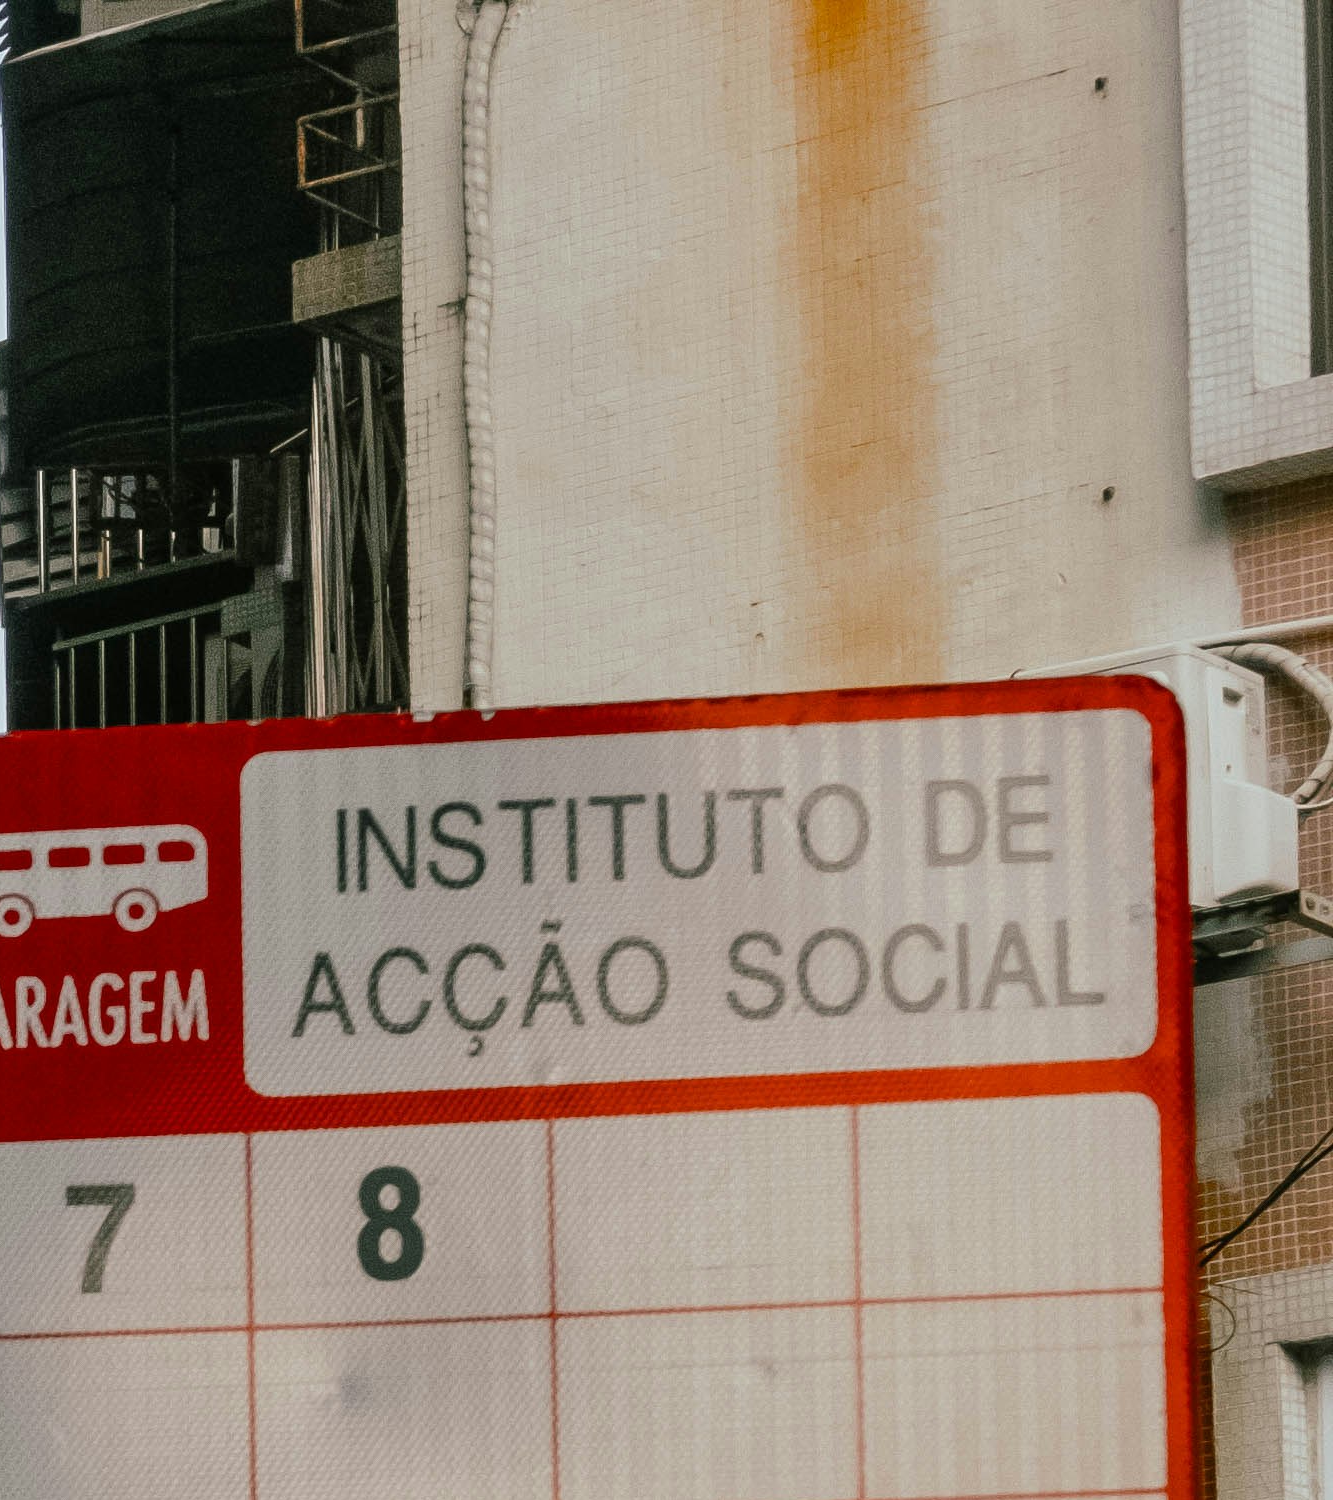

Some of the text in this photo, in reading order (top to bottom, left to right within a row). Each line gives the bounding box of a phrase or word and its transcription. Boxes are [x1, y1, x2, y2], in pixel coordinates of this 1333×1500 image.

[336, 774, 1053, 893] INSTITUTO DE
[291, 918, 1105, 1057] ACÇÃO SOCIAL
[65, 1165, 425, 1295] 7 8
